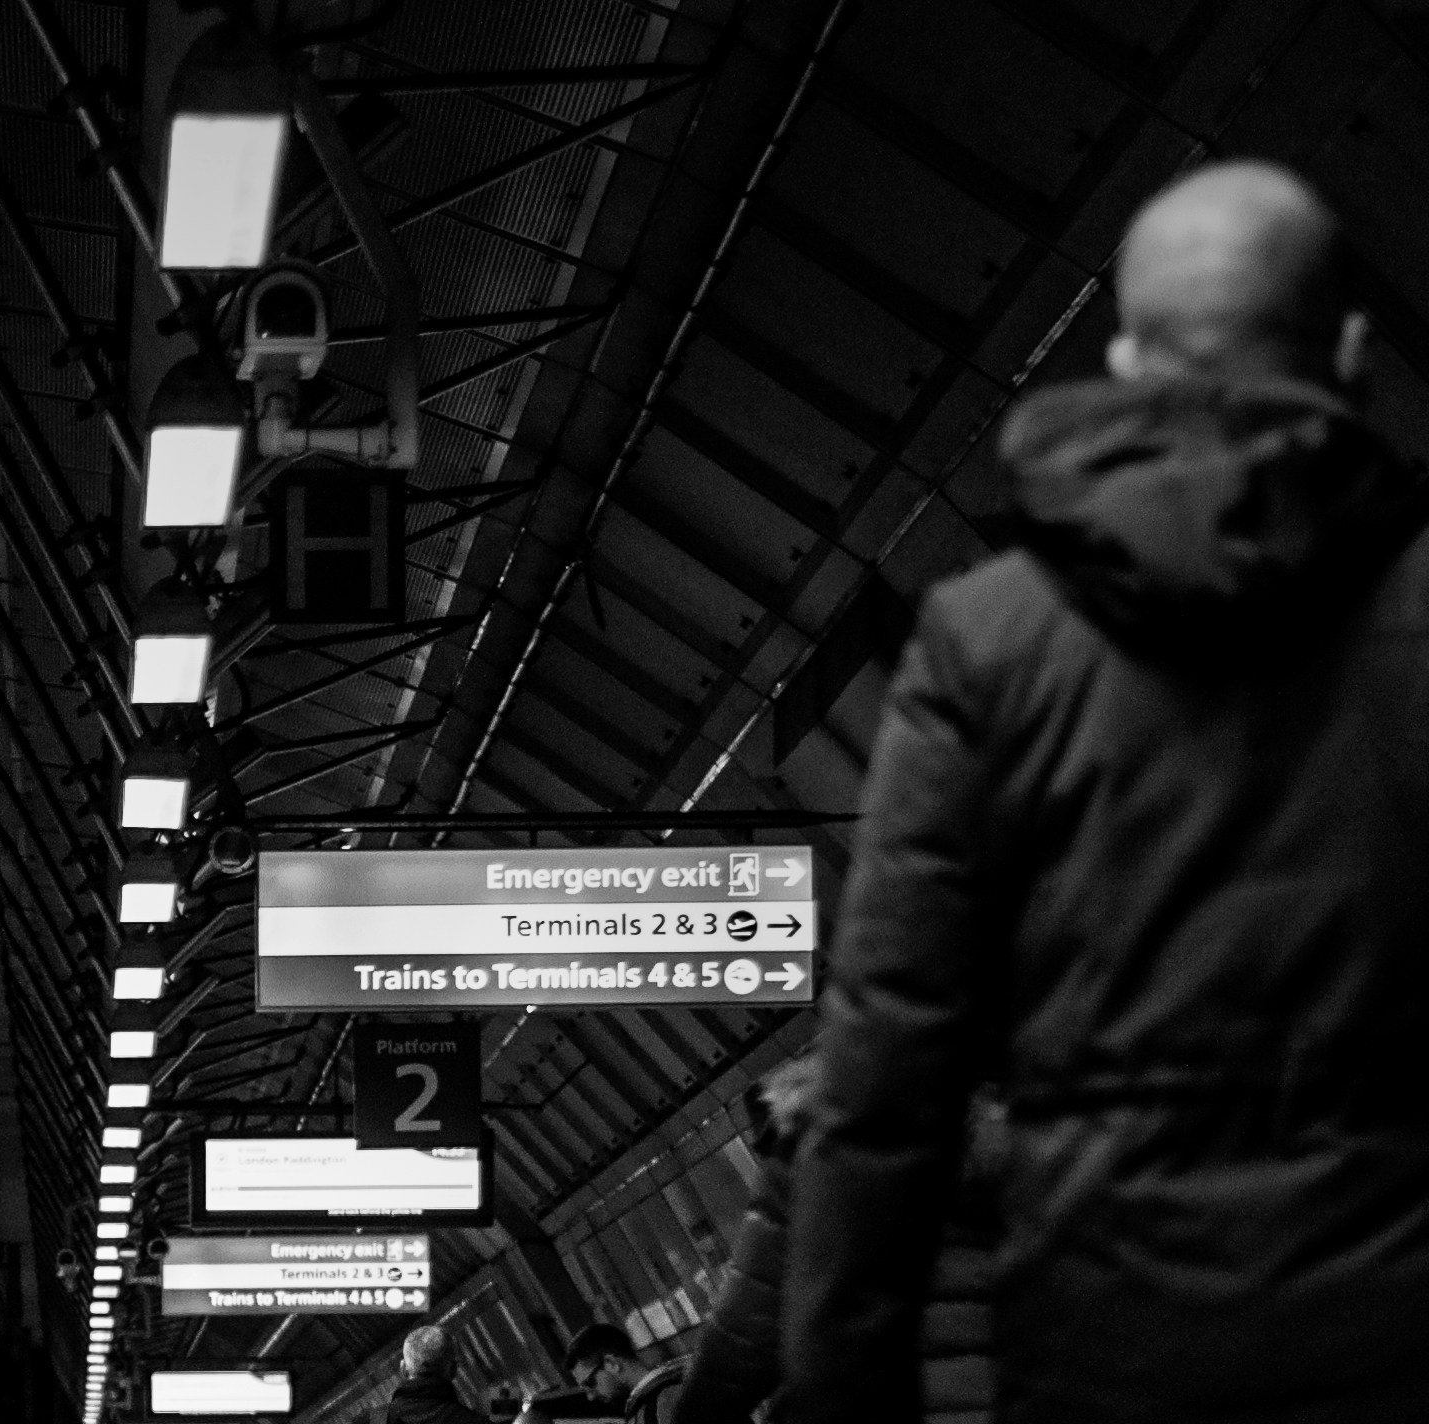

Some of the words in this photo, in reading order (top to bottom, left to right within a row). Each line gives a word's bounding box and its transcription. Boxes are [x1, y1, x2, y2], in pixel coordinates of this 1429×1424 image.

[485, 863, 655, 895] Emergency
[660, 860, 721, 888] exit
[500, 913, 642, 937] Terminals
[650, 912, 667, 936] 2
[675, 913, 695, 935] &
[702, 912, 719, 935] 3
[354, 963, 447, 991] Trains
[453, 965, 488, 990] to
[491, 961, 642, 990] Terminals
[647, 962, 668, 988] 4
[701, 961, 720, 987] 5
[375, 1038, 458, 1055] Platform
[394, 1062, 442, 1132] 2
[270, 1242, 353, 1260] Emergency
[354, 1242, 385, 1259] exit
[280, 1267, 347, 1280] Terminals
[351, 1267, 360, 1279] 2
[208, 1290, 255, 1307] Trains
[255, 1292, 275, 1307] to
[274, 1290, 347, 1307] Terminals
